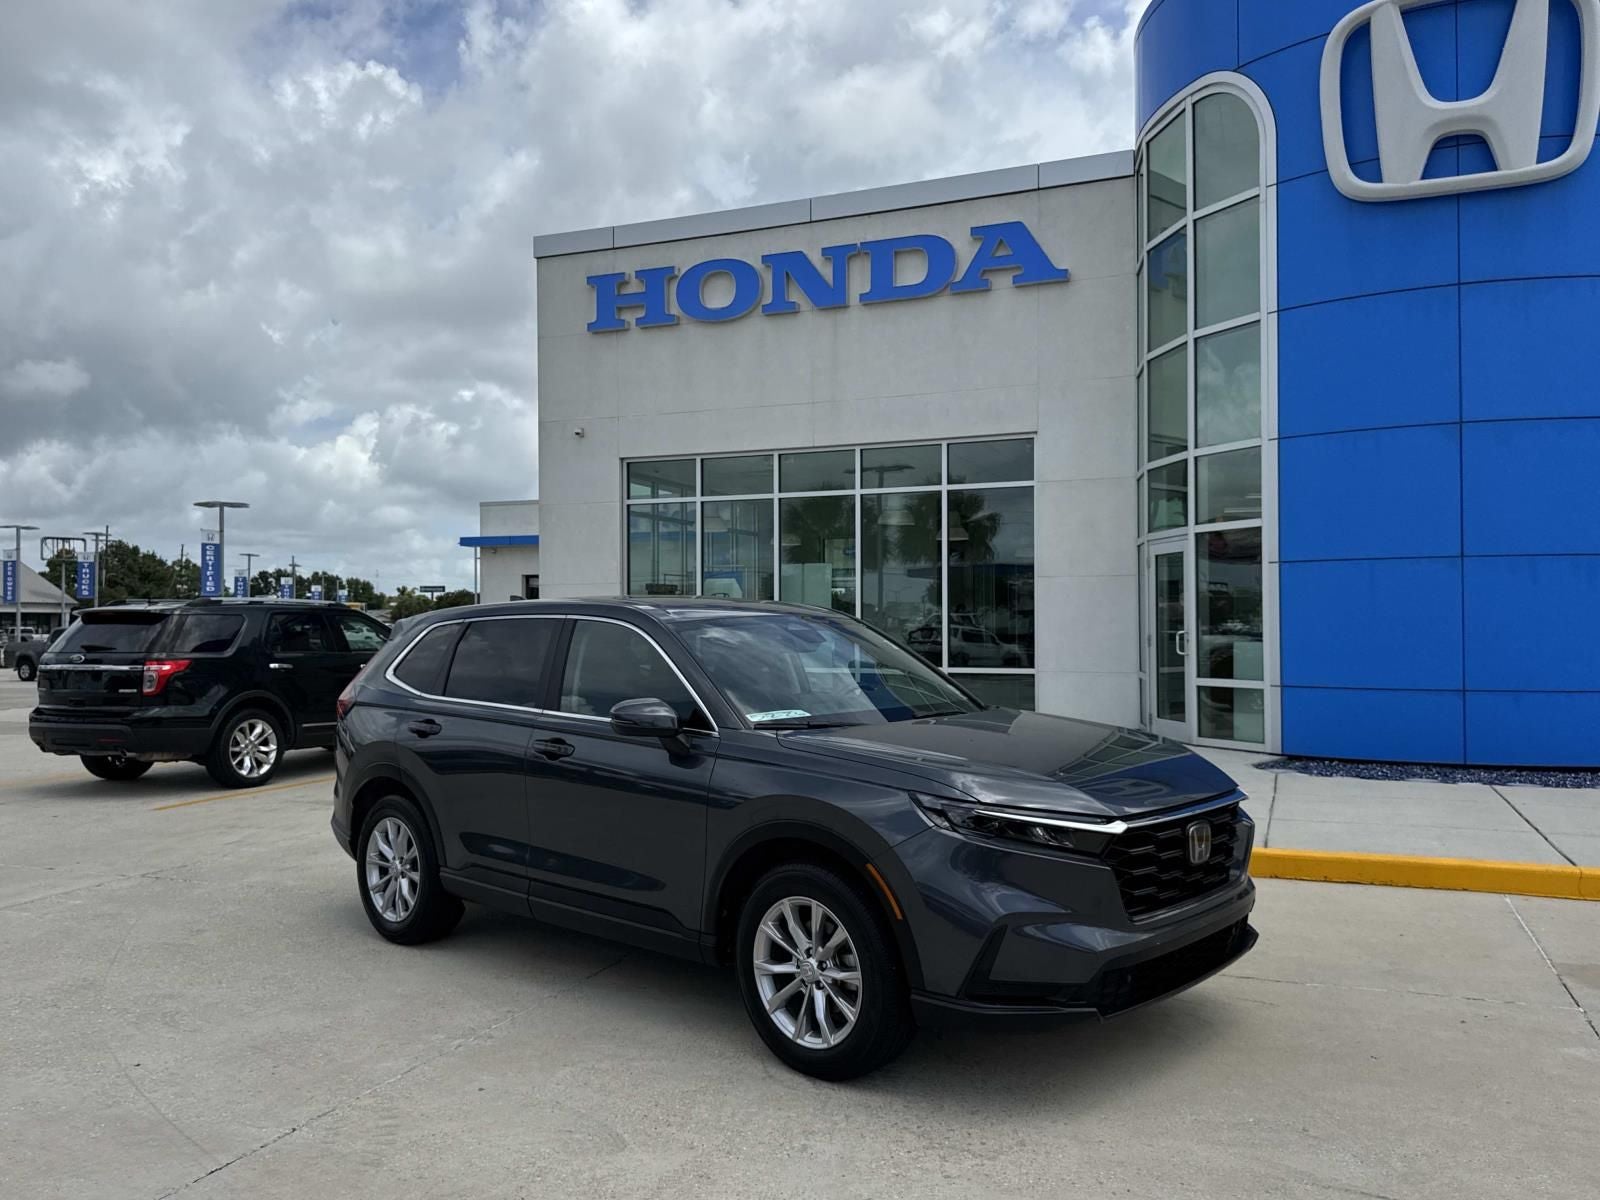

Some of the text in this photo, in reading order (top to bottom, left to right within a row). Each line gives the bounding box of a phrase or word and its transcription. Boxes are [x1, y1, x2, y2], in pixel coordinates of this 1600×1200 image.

[586, 221, 1071, 334] HONDA
[82, 563, 90, 596] TRUCKS
[206, 545, 215, 592] CERTIFIED
